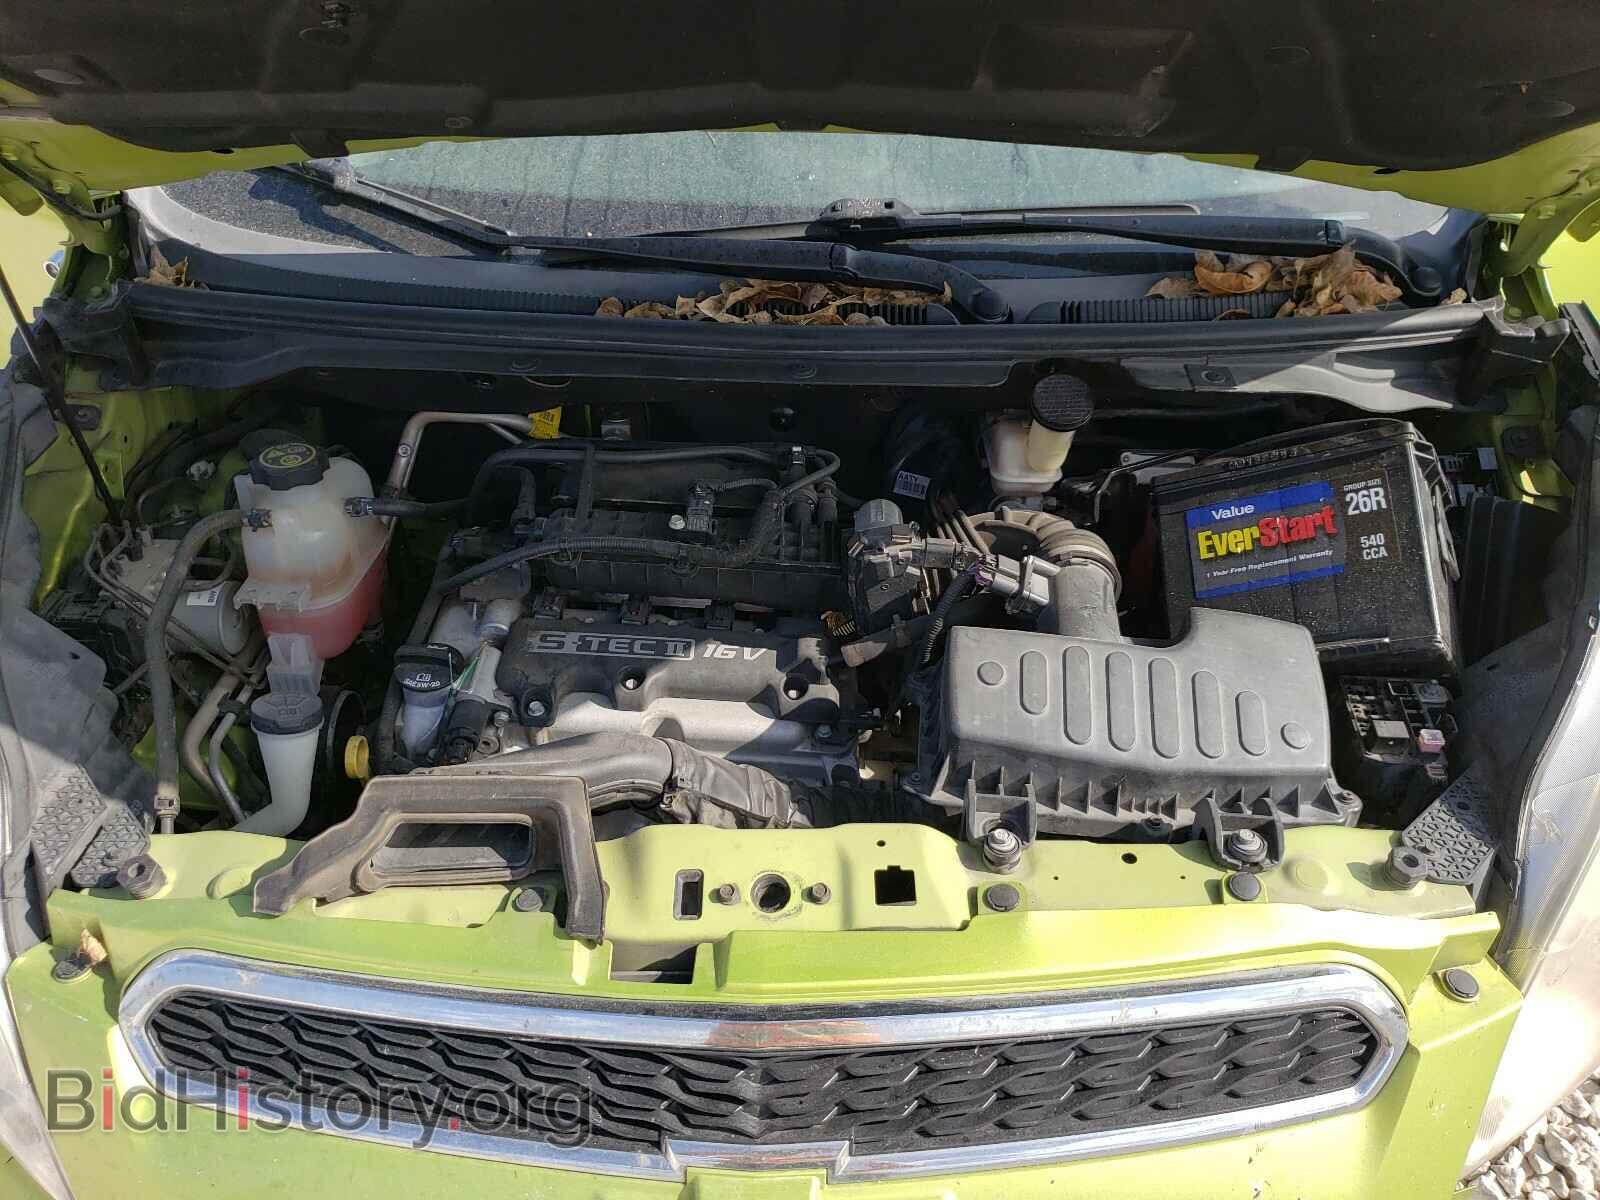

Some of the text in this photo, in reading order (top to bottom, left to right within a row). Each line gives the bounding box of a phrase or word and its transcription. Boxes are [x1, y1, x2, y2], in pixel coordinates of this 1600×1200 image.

[1345, 487, 1387, 515] 26R
[1211, 504, 1255, 520] Value
[1197, 505, 1338, 560] EverStart
[1360, 532, 1385, 548] 540
[1230, 565, 1247, 574] Free
[1248, 555, 1297, 570] Replacement
[1298, 549, 1334, 561] Warranty
[1362, 546, 1388, 560] CCA
[703, 641, 768, 660] 16V
